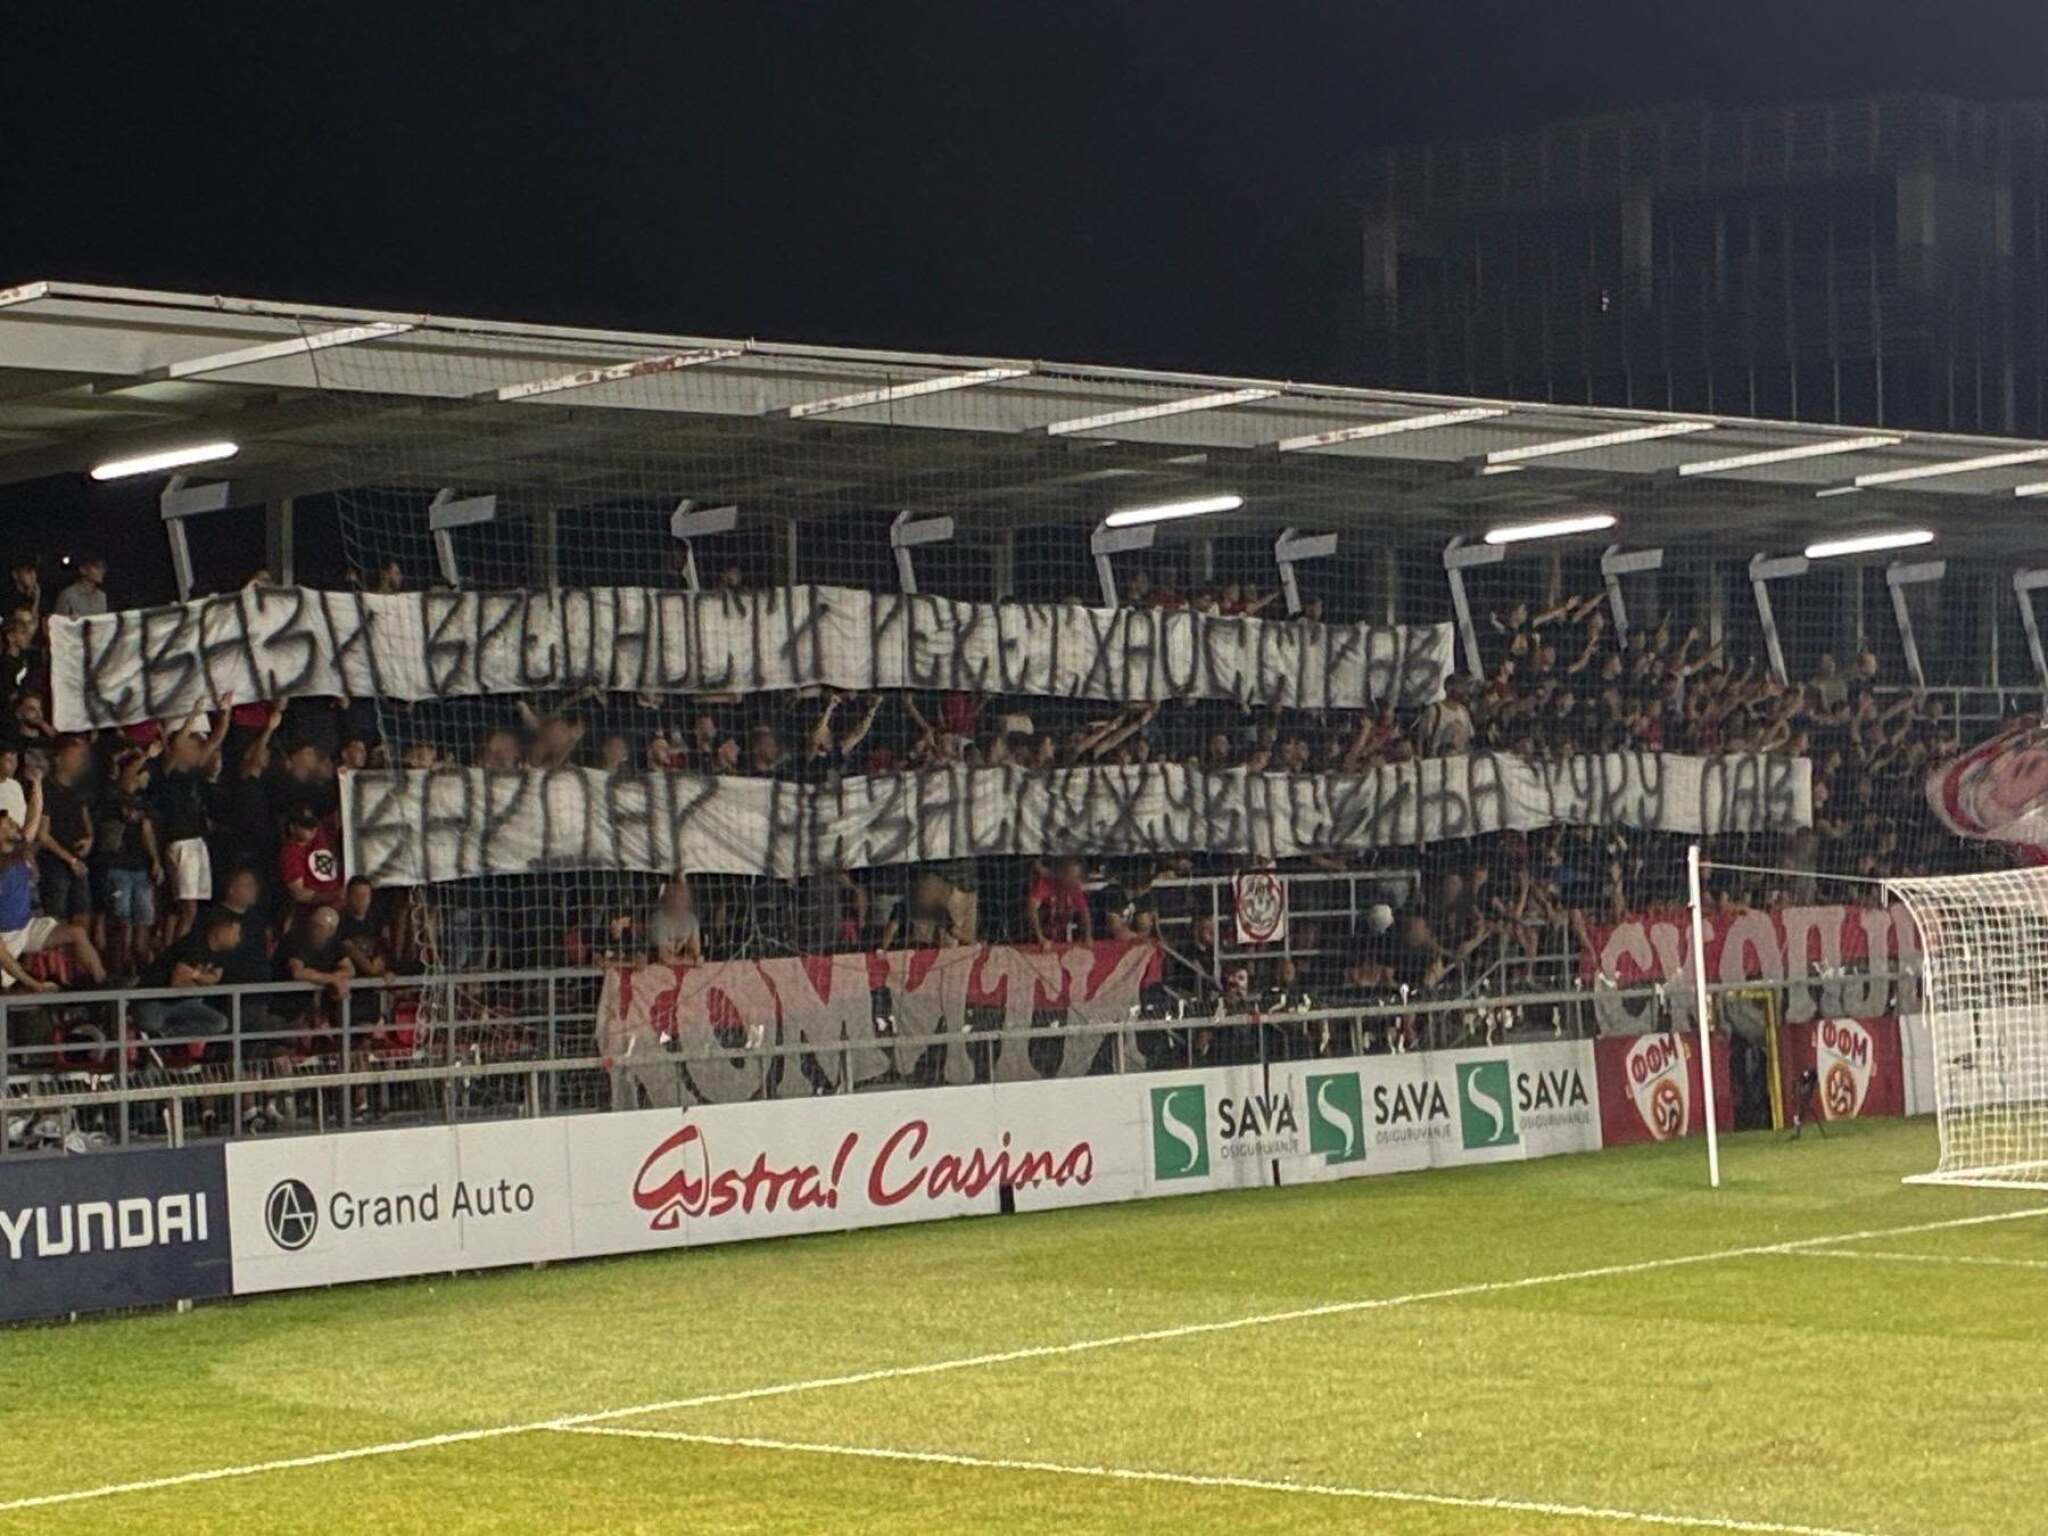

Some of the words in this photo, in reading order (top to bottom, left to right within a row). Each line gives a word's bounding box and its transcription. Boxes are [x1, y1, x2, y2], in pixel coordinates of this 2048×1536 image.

[82, 585, 387, 724] КВАЗИ
[352, 766, 718, 884] ВАРДАР
[1373, 1081, 1450, 1125] SAVA
[1517, 1068, 1589, 1111] SAVA
[1217, 1093, 1298, 1139] SAVA
[1376, 1124, 1451, 1144] OSIGURUVANJE
[868, 1120, 1094, 1206] Casino
[0, 1192, 208, 1260] YUNDAI
[330, 1184, 439, 1229] Grand
[452, 1179, 534, 1218] Auto
